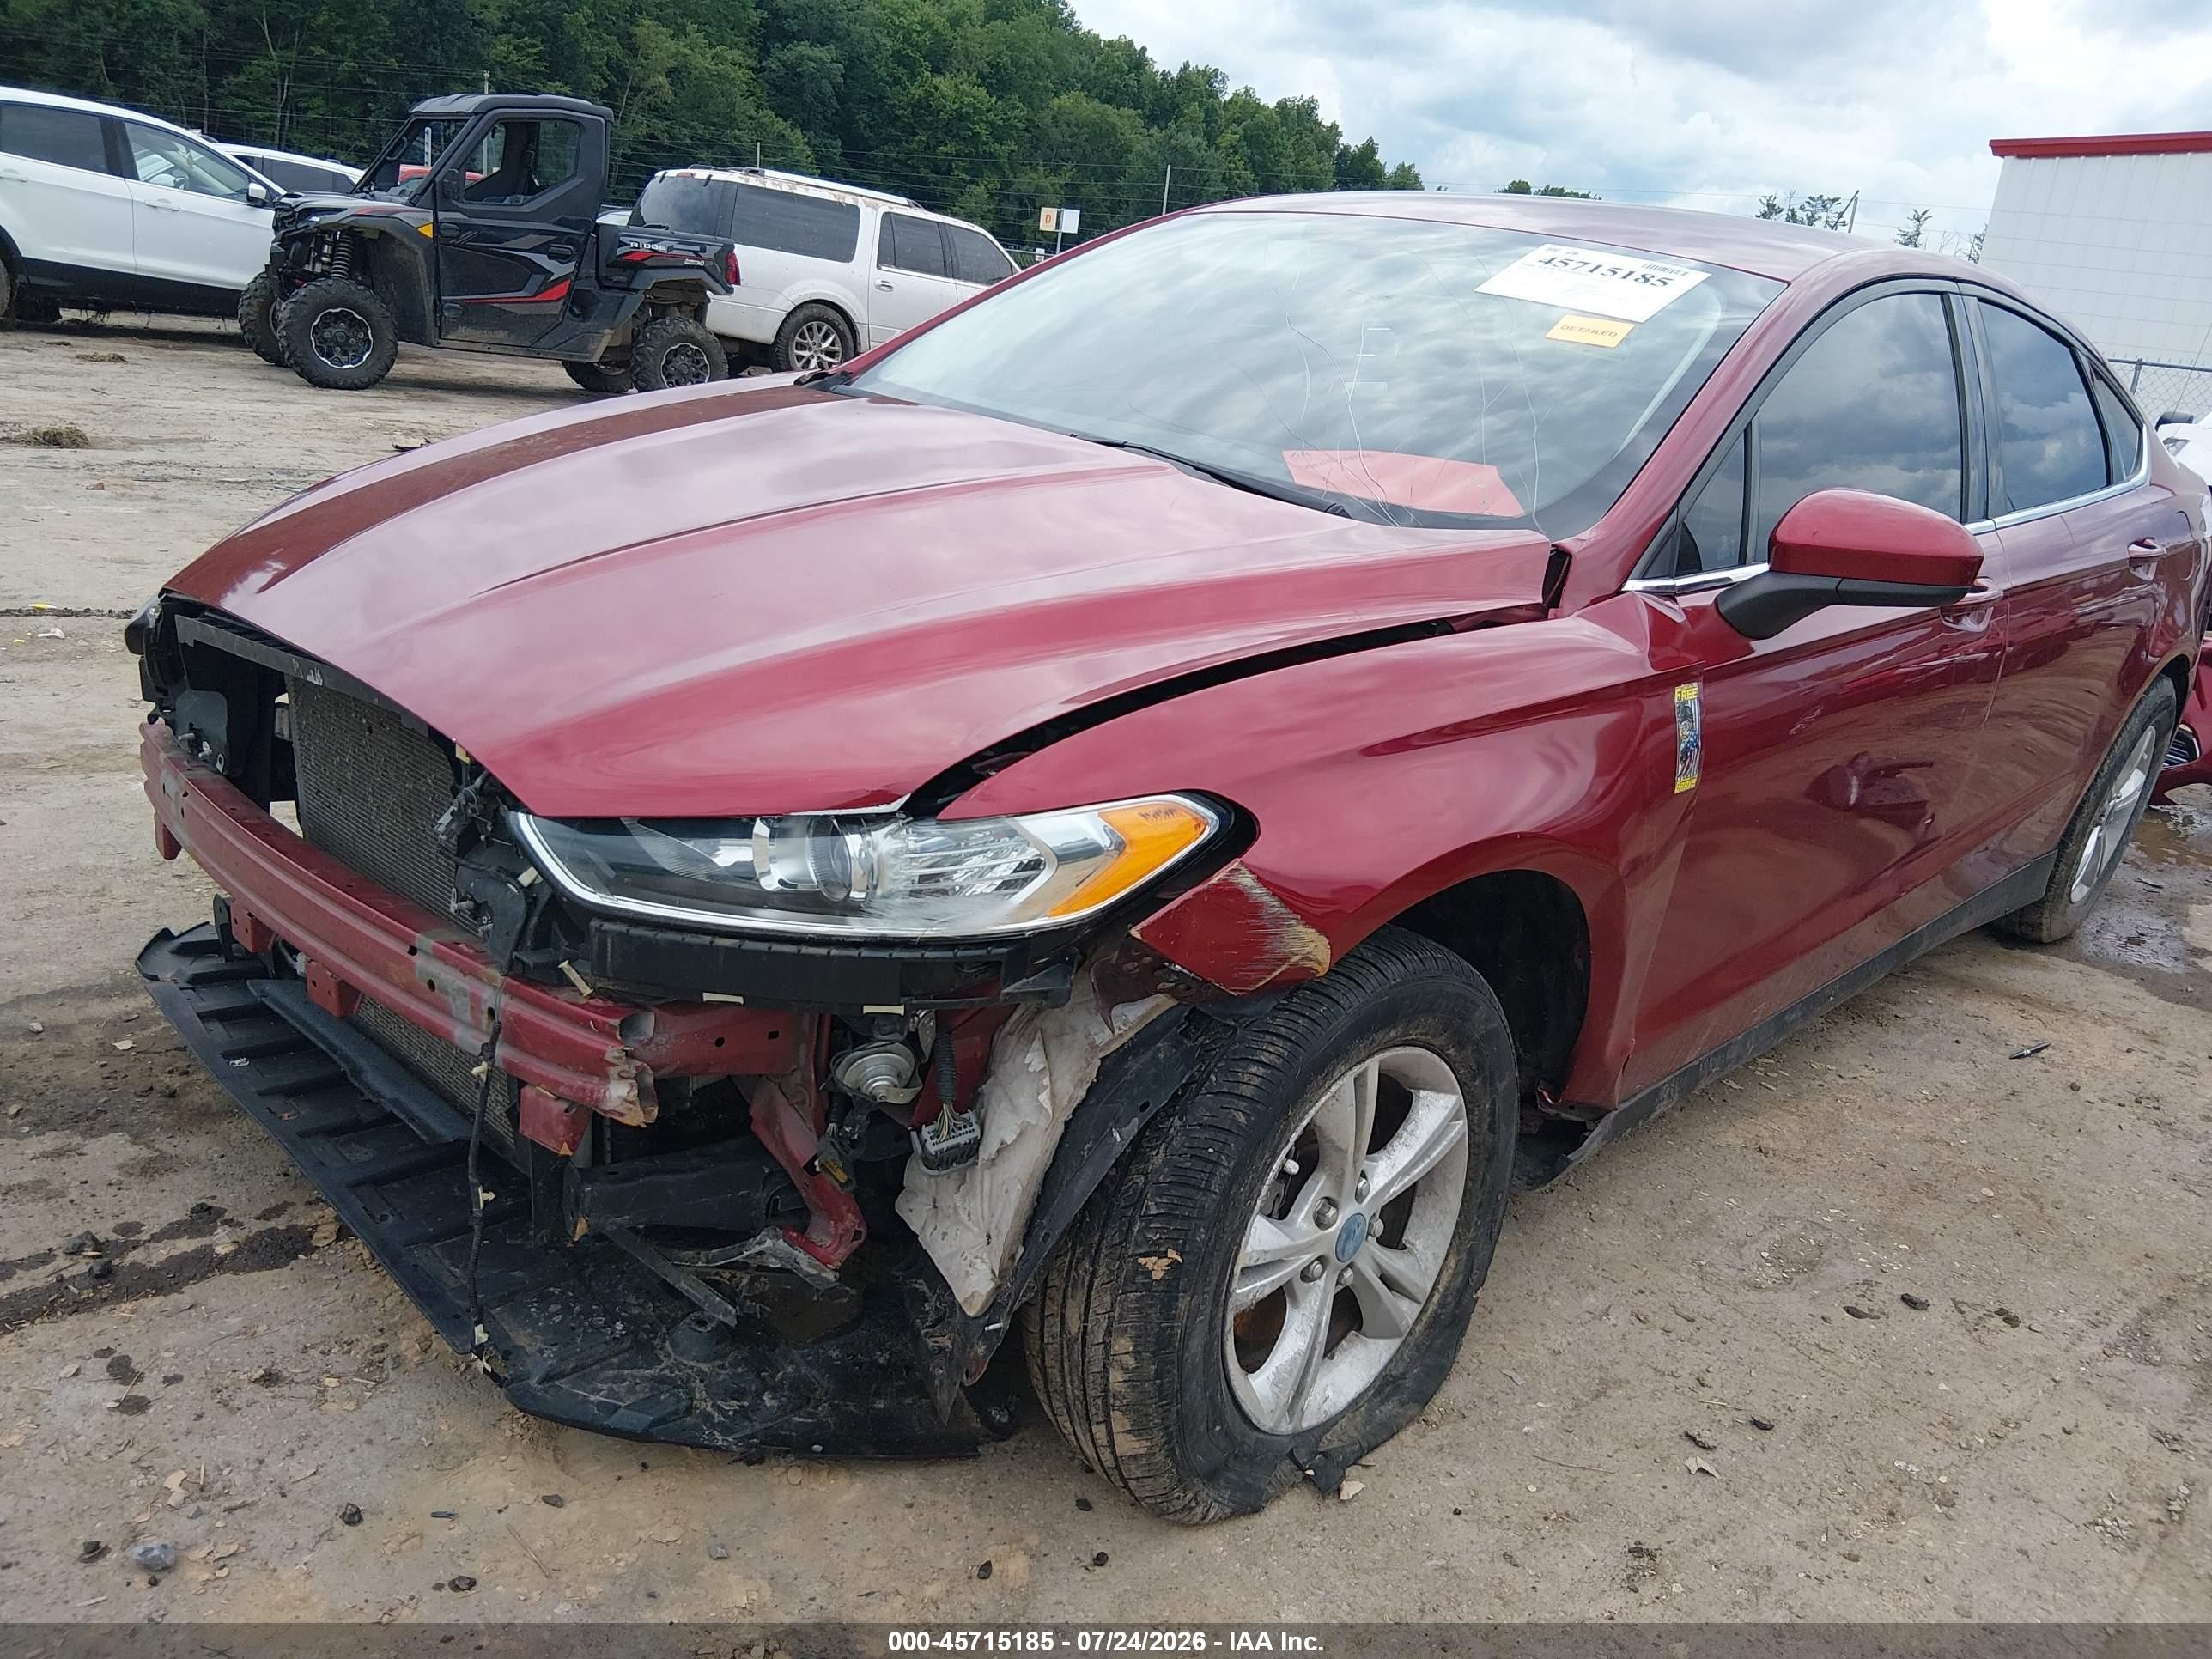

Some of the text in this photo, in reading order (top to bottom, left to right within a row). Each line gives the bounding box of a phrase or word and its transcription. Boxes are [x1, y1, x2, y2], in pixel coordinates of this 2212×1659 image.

[1045, 214, 1052, 224] D
[630, 241, 666, 251] RIDGE
[1538, 257, 1675, 288] 45715185
[1559, 324, 1619, 338] DETAILED
[1675, 688, 1698, 702] FREE
